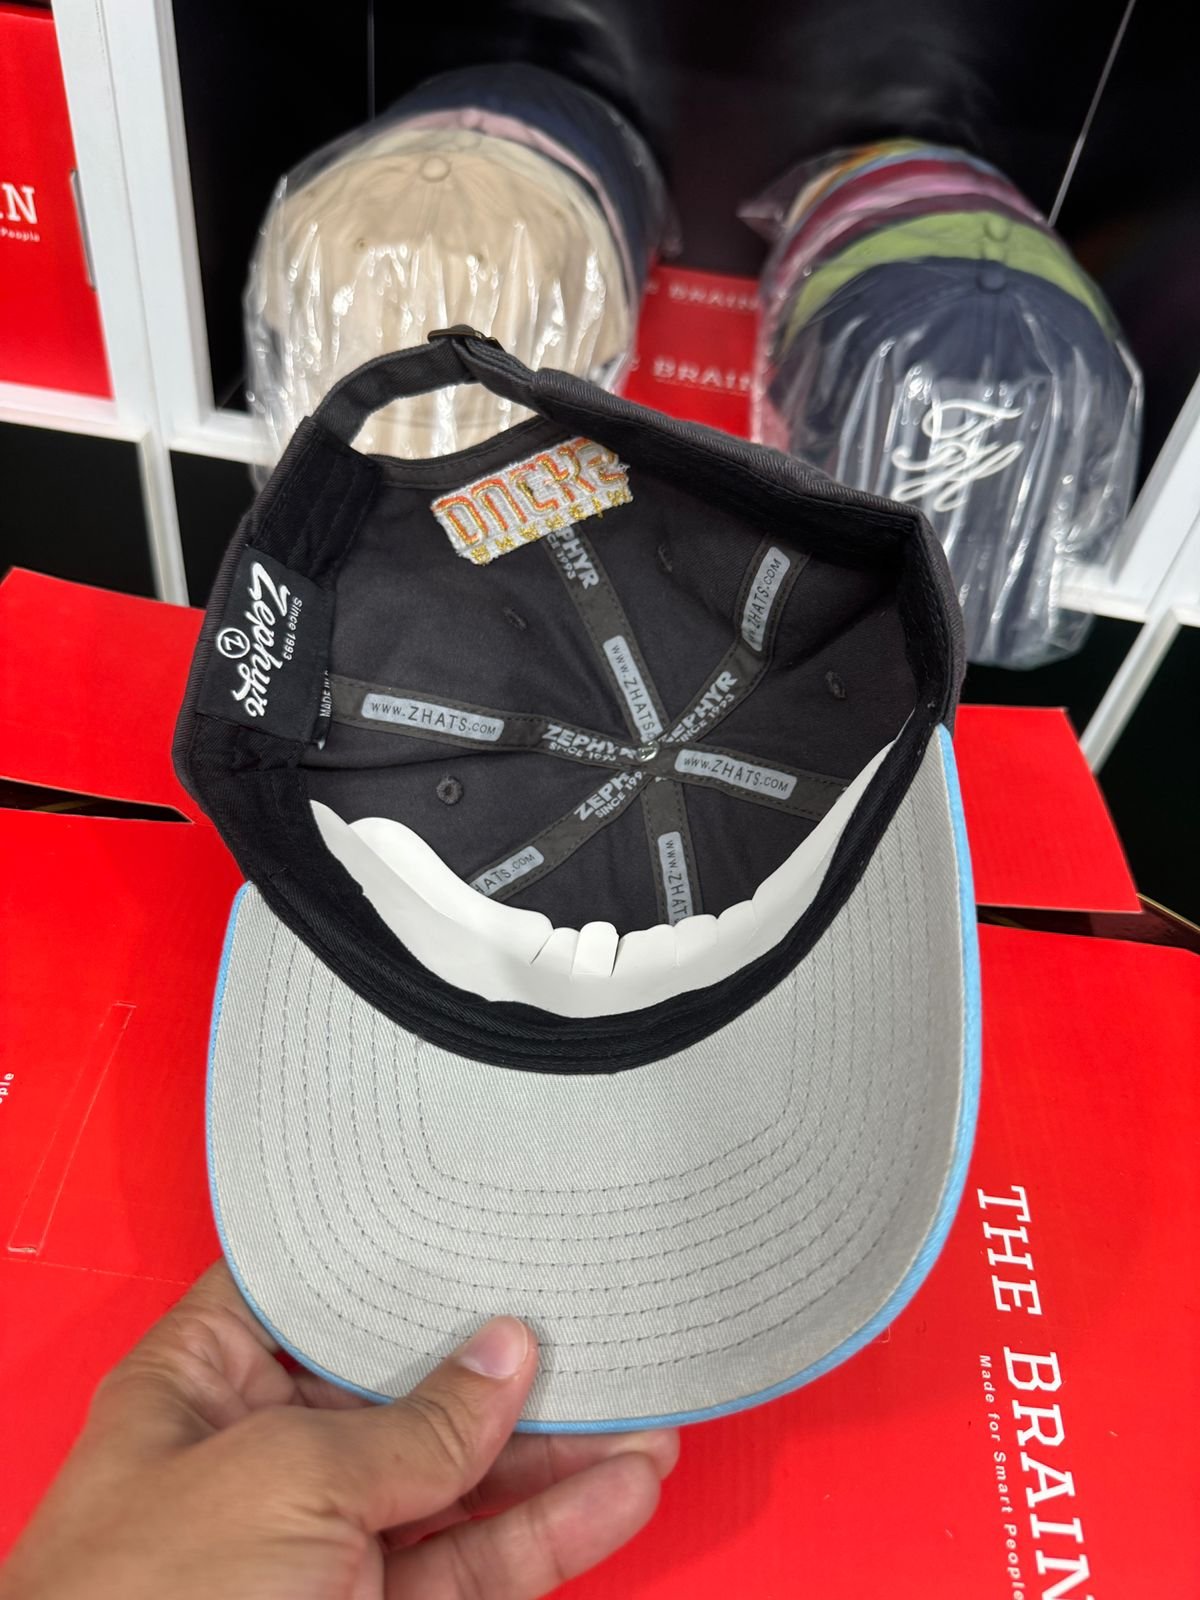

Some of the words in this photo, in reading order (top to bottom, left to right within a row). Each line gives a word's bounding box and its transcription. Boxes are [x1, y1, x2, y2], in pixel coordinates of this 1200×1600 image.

[555, 526, 600, 590] PHYR
[287, 596, 303, 631] Since
[231, 561, 291, 718] Zephyr
[282, 633, 298, 661] 1993
[675, 719, 708, 743] INCE
[573, 771, 631, 821] ZEPH
[594, 791, 626, 819] SINCE
[625, 771, 648, 791] 199
[976, 1184, 1042, 1315] THE
[979, 1354, 996, 1403] Made
[987, 1411, 1001, 1442] for
[993, 1450, 1014, 1514] Smart
[1003, 1346, 1096, 1600] BRAIN
[1003, 1522, 1025, 1600] People
